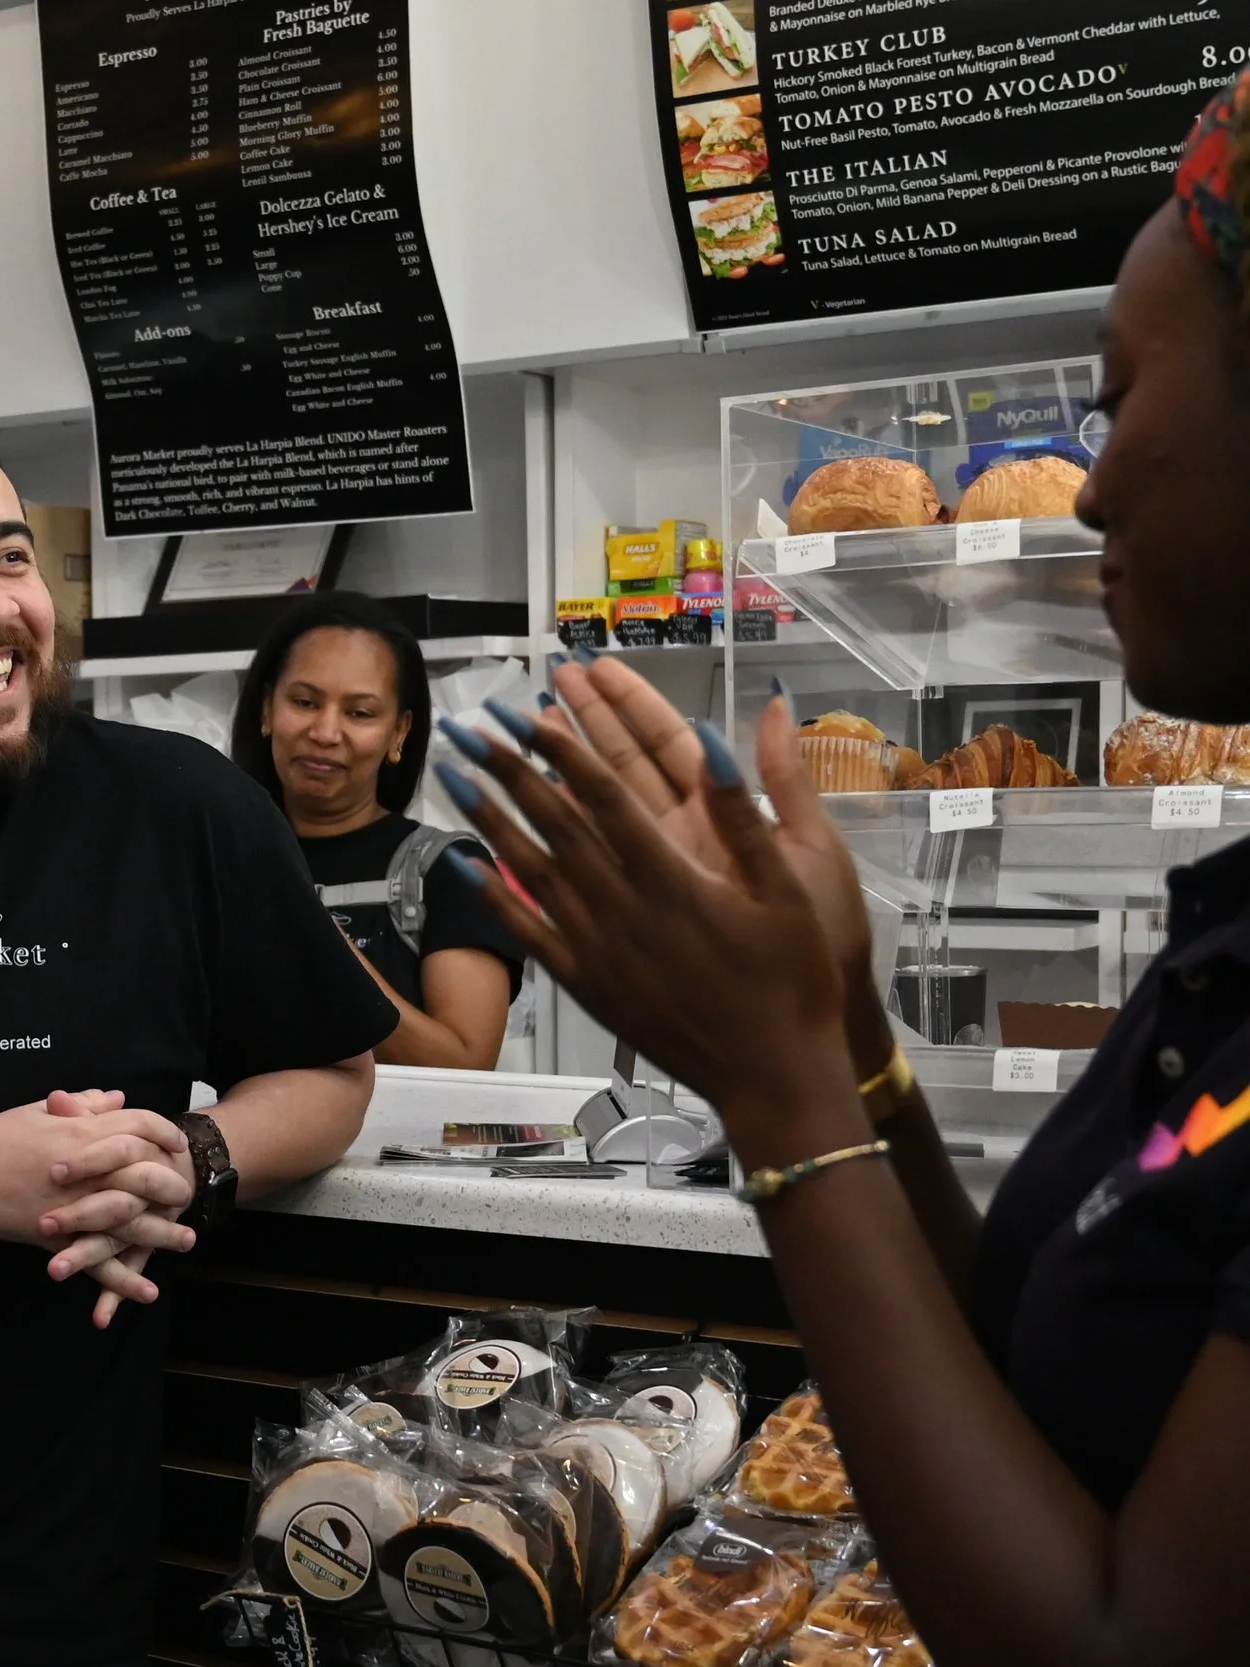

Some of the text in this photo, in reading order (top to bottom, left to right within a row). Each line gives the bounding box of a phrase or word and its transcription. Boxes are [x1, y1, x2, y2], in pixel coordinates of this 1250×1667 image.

[276, 0, 354, 26] Pastries by
[769, 0, 814, 17] Branded
[769, 22, 780, 32] &
[779, 11, 844, 31] Mayonnaise
[844, 8, 858, 18] on
[862, 0, 908, 15] Marbled
[263, 12, 369, 43] Fresh Baguette
[98, 47, 157, 67] Espresso
[238, 46, 311, 66] Almond Croissant
[772, 26, 945, 69] TURKEY CLUB
[773, 9, 1220, 88] Hickory Smoked Black Forest Turkey, Bacon & Vermont Cheddar with Lettuce,
[1202, 45, 1250, 68] 8.0
[238, 58, 320, 79] Chocolate Croissant
[774, 49, 1054, 103] Tomato, Onion & Mayonnaise on Multigrain Bread
[238, 76, 300, 93] Plain Croissant
[269, 90, 299, 100] Cheese
[301, 82, 341, 95] Croissant
[779, 65, 1116, 131] TOMATO PESTO AVOCADO
[238, 101, 301, 119] Cinnamon Roll
[782, 72, 1236, 150] Nut-Free Basil Pesto, Tomato, Avocado & Fresh Mozzarella on Sourdough Bread
[239, 114, 312, 133] Blueberry Muffin
[786, 150, 946, 187] THE ITALIAN
[789, 146, 1167, 205] Prosciutto Di Parma, Genoa Salami, Pepperoni & Picante Provolone
[90, 187, 177, 211] Coffee & Tea
[260, 184, 385, 215] Dolcezza Gelato &
[793, 163, 1148, 219] Tomato, Onion, Mild Banana Pepper & Deli Dressing on a Rustic
[258, 208, 398, 237] Hershey's Ice Cream
[798, 221, 956, 253] TUNA SALAD
[801, 228, 1077, 270] Tuna Salad, Lettuce & Tomato on Multigrain Bread
[313, 301, 382, 320] Breakfast
[134, 325, 191, 342] Add-ons
[996, 405, 1058, 429] NyQuil
[962, 534, 1006, 546] Croissant
[970, 527, 999, 536] Cheese
[625, 543, 656, 554] HALLS
[558, 601, 594, 611] BAYER
[938, 799, 984, 810] Croissant
[1158, 798, 1212, 808] Croissant
[1168, 789, 1205, 798] Almond
[1170, 806, 1200, 817] $4.50
